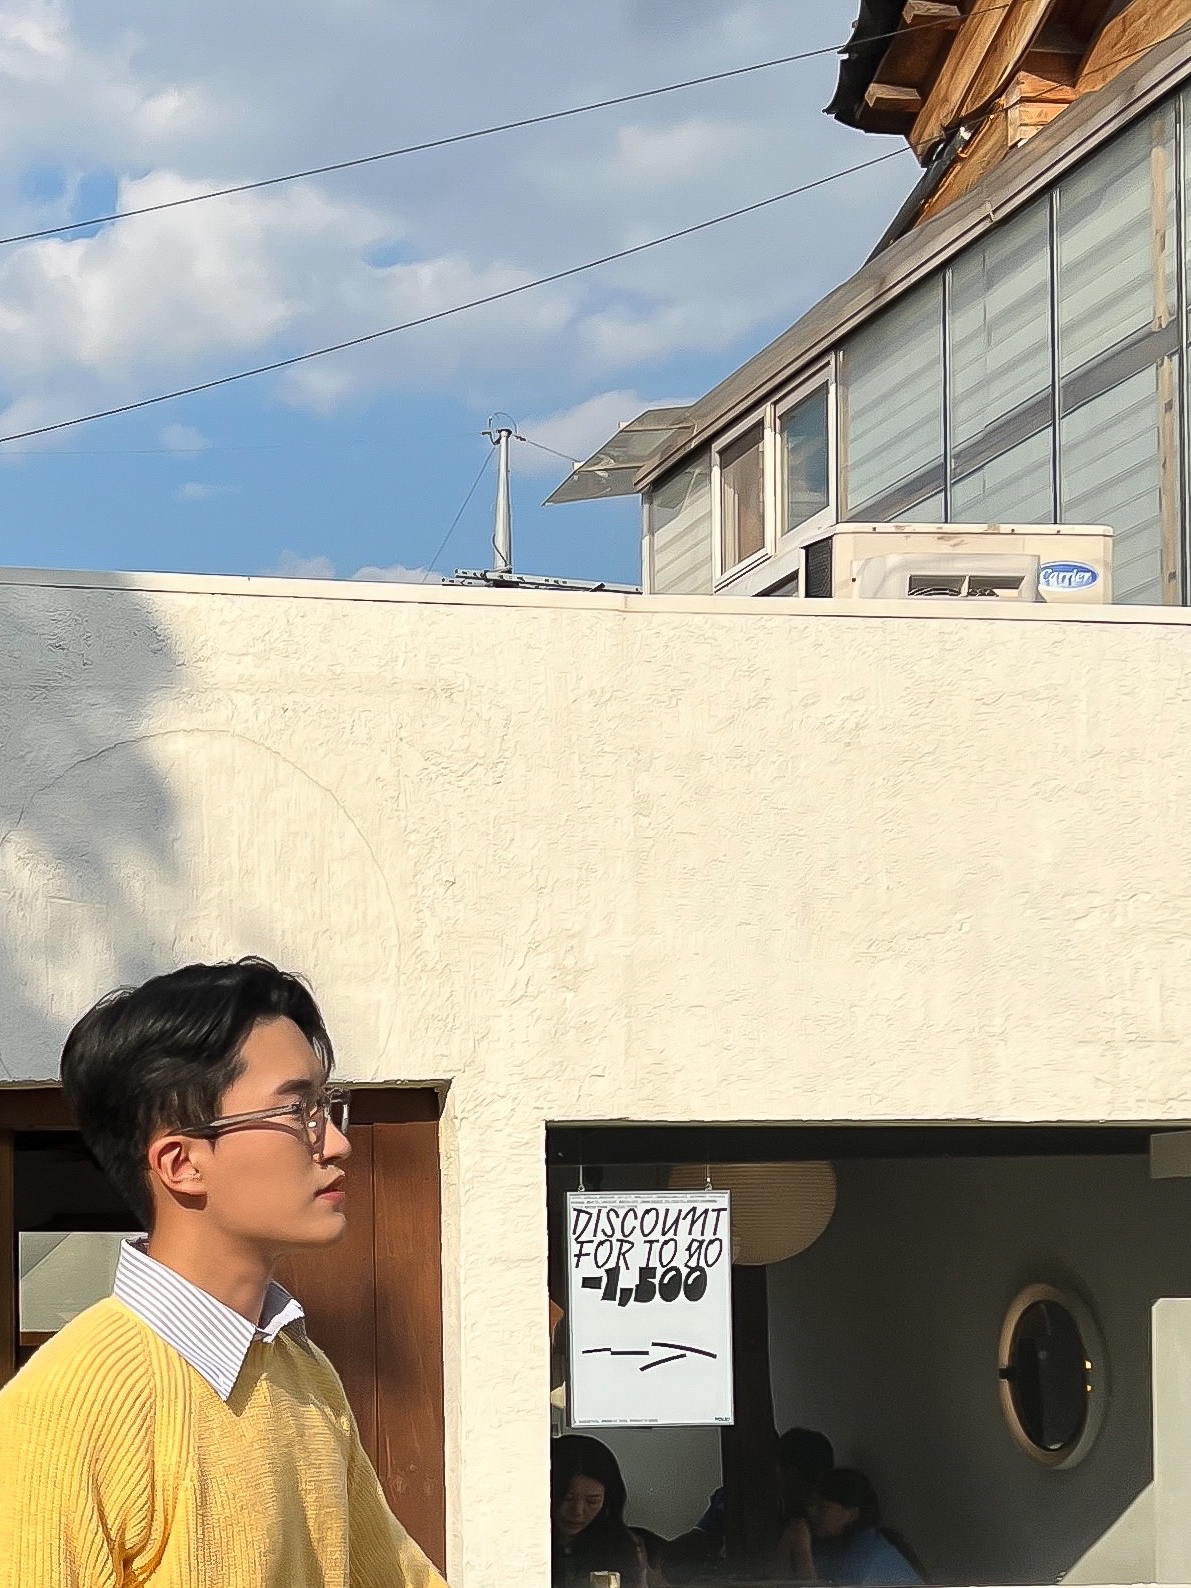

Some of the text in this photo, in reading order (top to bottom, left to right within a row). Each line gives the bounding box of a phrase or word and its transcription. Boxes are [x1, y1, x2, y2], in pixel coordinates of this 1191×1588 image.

[572, 1206, 728, 1241] DISCOUNT
[574, 1238, 635, 1270] FOR
[643, 1237, 678, 1268] TO
[581, 1265, 708, 1307] -1,500
